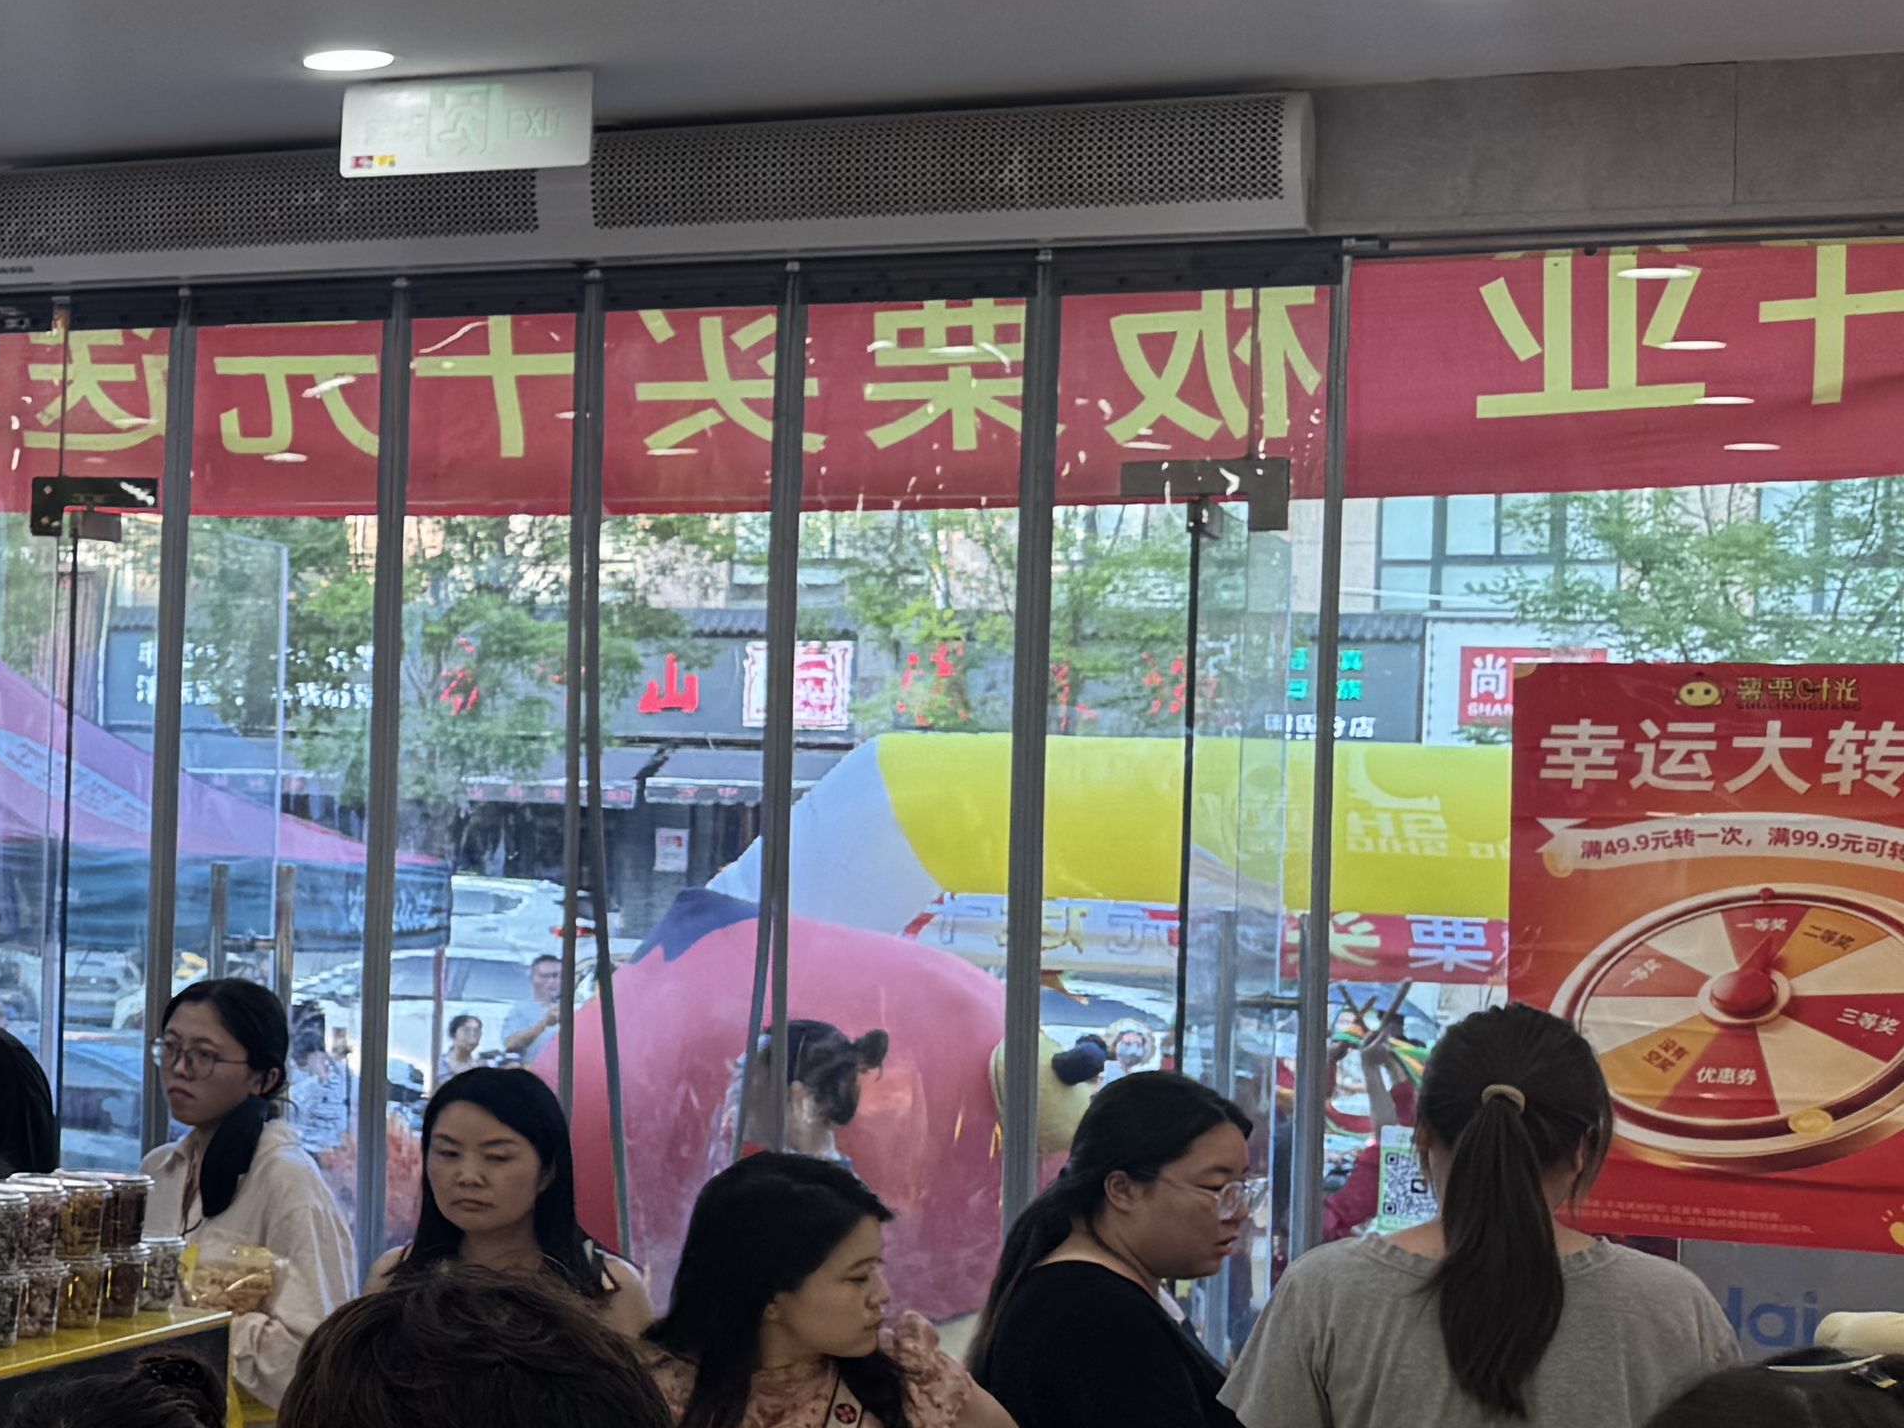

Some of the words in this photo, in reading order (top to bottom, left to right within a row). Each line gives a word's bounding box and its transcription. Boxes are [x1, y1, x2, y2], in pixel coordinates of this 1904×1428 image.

[1538, 717, 1904, 797] 幸运大转
[1836, 1008, 1902, 1036] 三等奖
[1696, 1066, 1757, 1086] 优惠券
